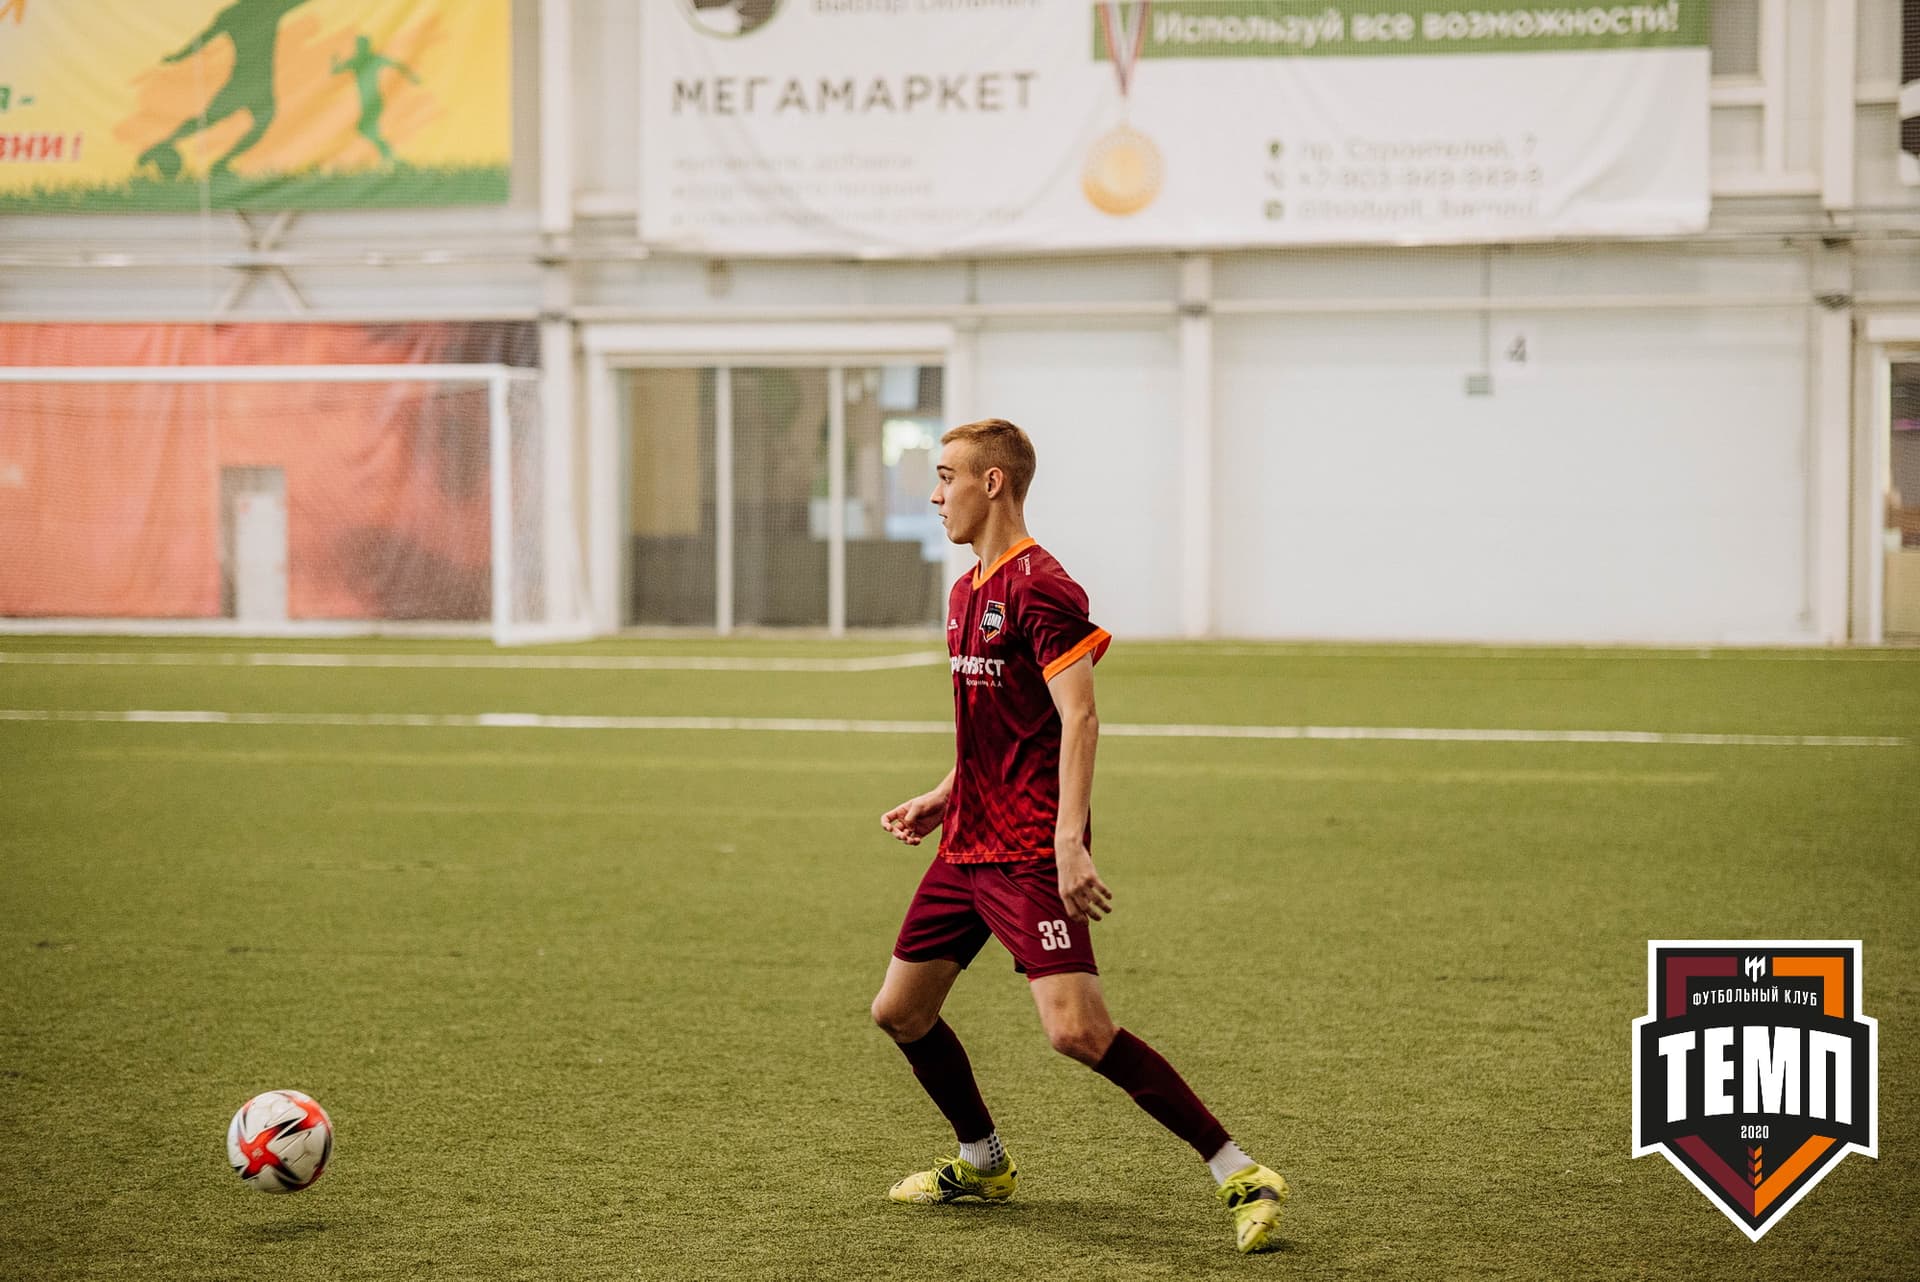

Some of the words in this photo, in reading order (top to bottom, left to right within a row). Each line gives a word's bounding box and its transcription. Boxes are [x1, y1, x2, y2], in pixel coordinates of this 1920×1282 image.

[1153, 10, 1345, 48] Используй
[1351, 13, 1415, 41] все
[1421, 2, 1680, 41] возможности!
[672, 71, 1040, 115] МЕГАМАРКЕТ
[1506, 334, 1529, 364] 4
[1038, 919, 1071, 951] 33
